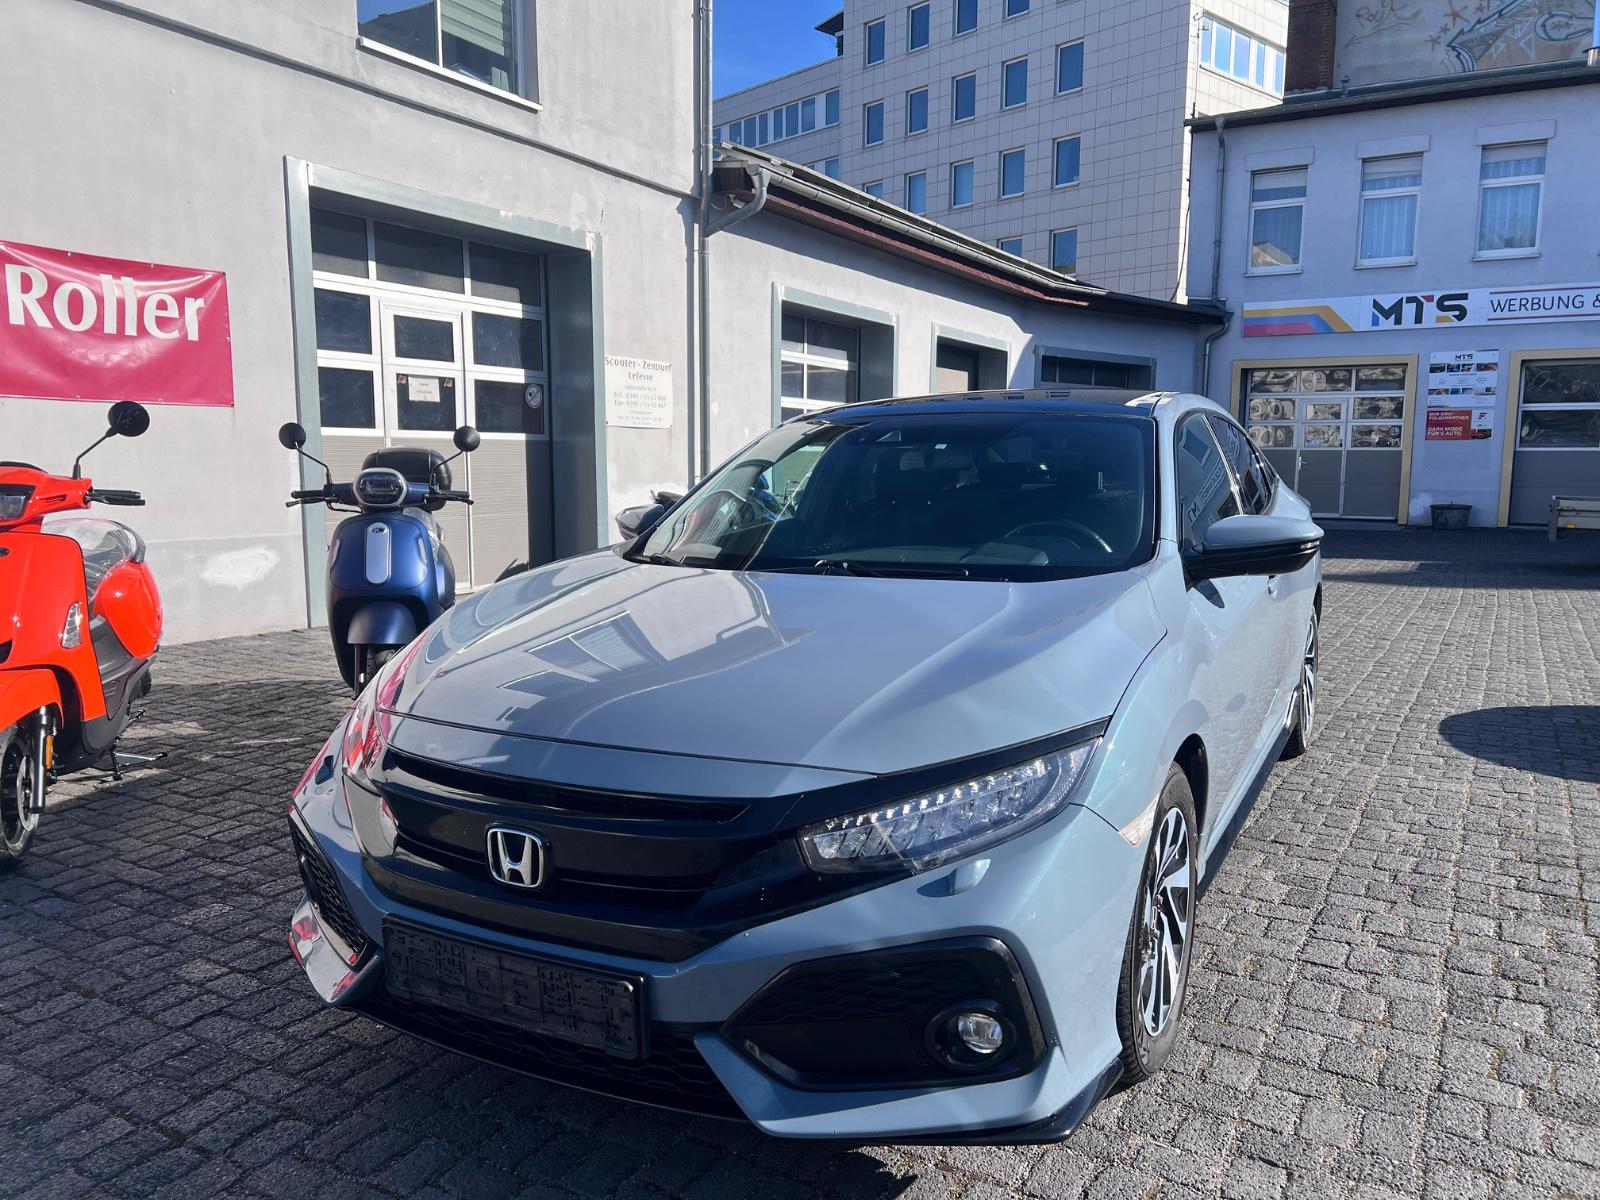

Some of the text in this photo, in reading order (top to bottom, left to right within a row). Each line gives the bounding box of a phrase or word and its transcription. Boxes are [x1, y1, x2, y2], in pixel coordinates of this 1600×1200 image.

[4, 263, 205, 342] Roller
[1371, 292, 1469, 327] MTS
[1490, 294, 1585, 312] WERBUNG
[604, 356, 636, 369] Scooter
